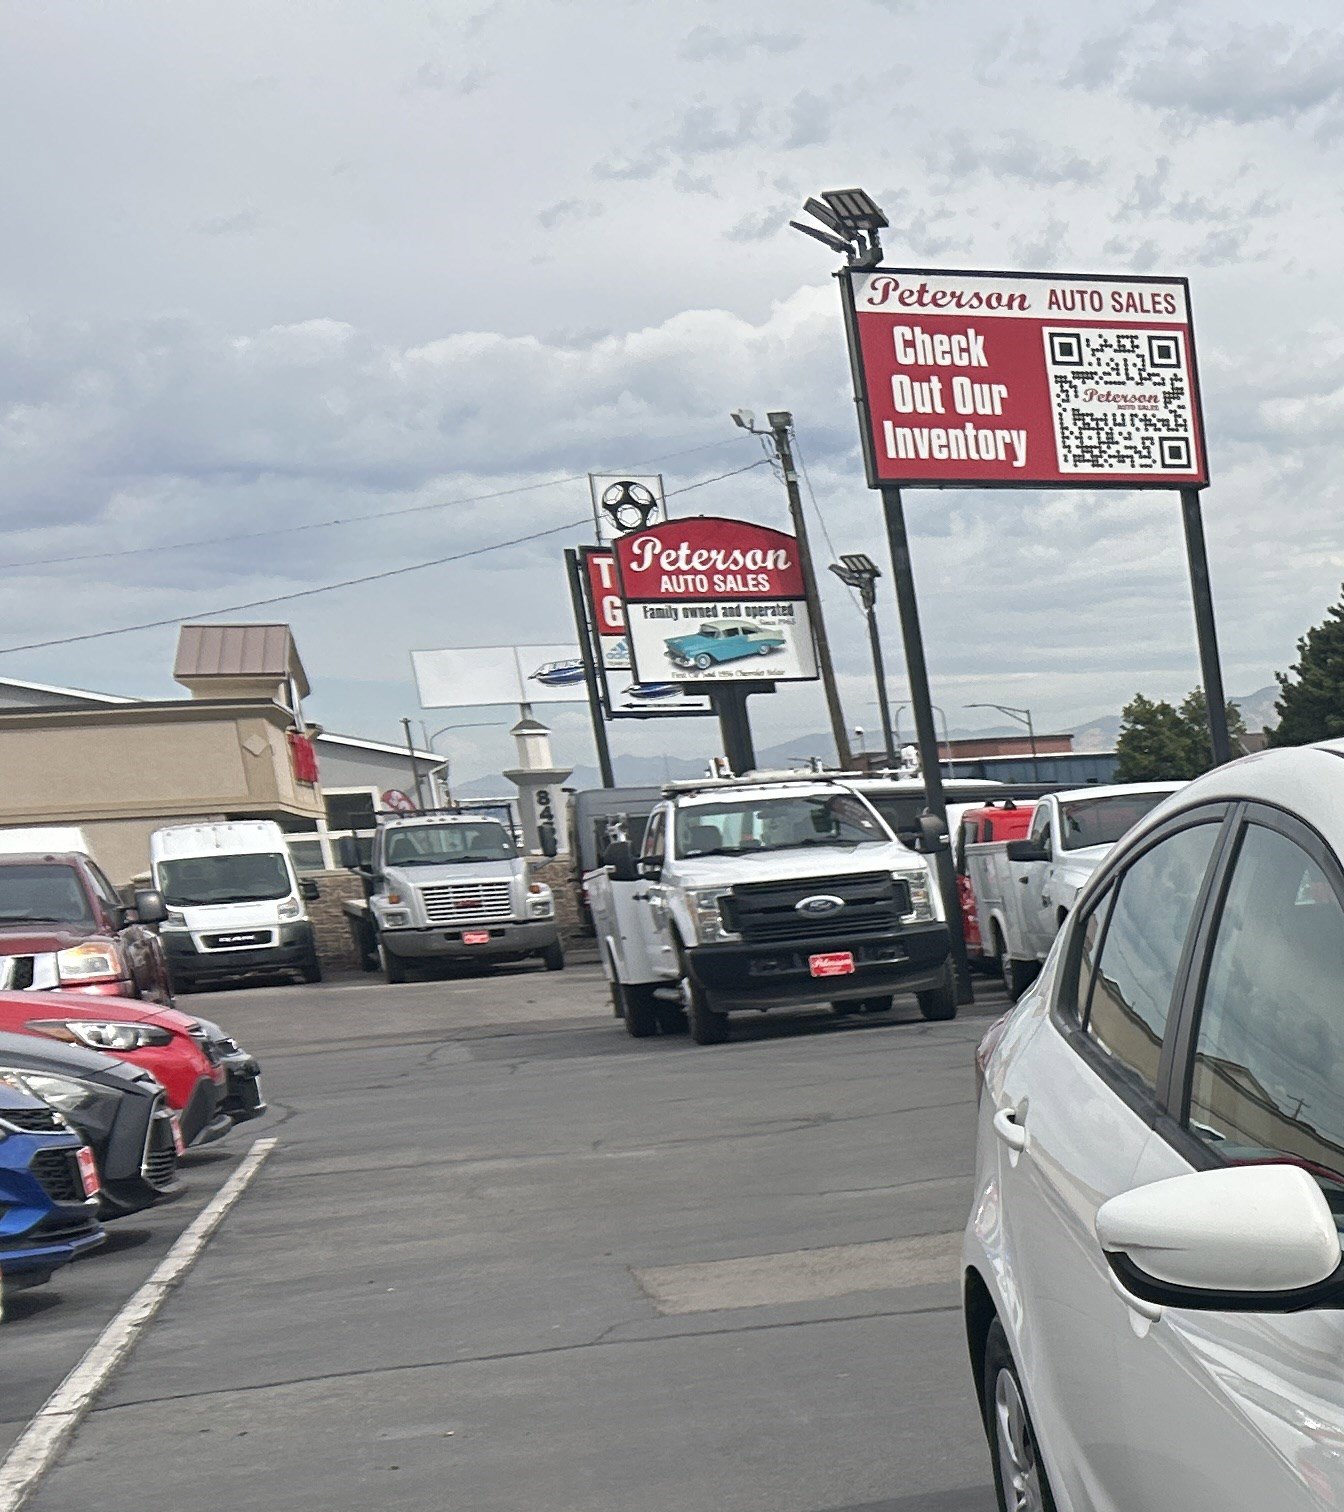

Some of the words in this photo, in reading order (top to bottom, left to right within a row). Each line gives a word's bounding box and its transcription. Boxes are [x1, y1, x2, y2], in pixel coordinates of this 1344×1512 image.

[867, 276, 1030, 311] Peterson
[1047, 289, 1104, 312] AUTO
[1111, 291, 1177, 315] SALES
[892, 325, 989, 368] Check
[891, 374, 945, 414] Out
[952, 376, 1008, 416] Our
[1083, 388, 1160, 404] Peterson
[882, 420, 1027, 468] Inventory
[630, 536, 791, 572] Peterson
[660, 575, 708, 593] AUTO
[714, 574, 770, 592] SALES
[642, 605, 678, 621] Family
[682, 604, 718, 619] owned
[721, 603, 741, 618] and
[745, 603, 794, 620] operated
